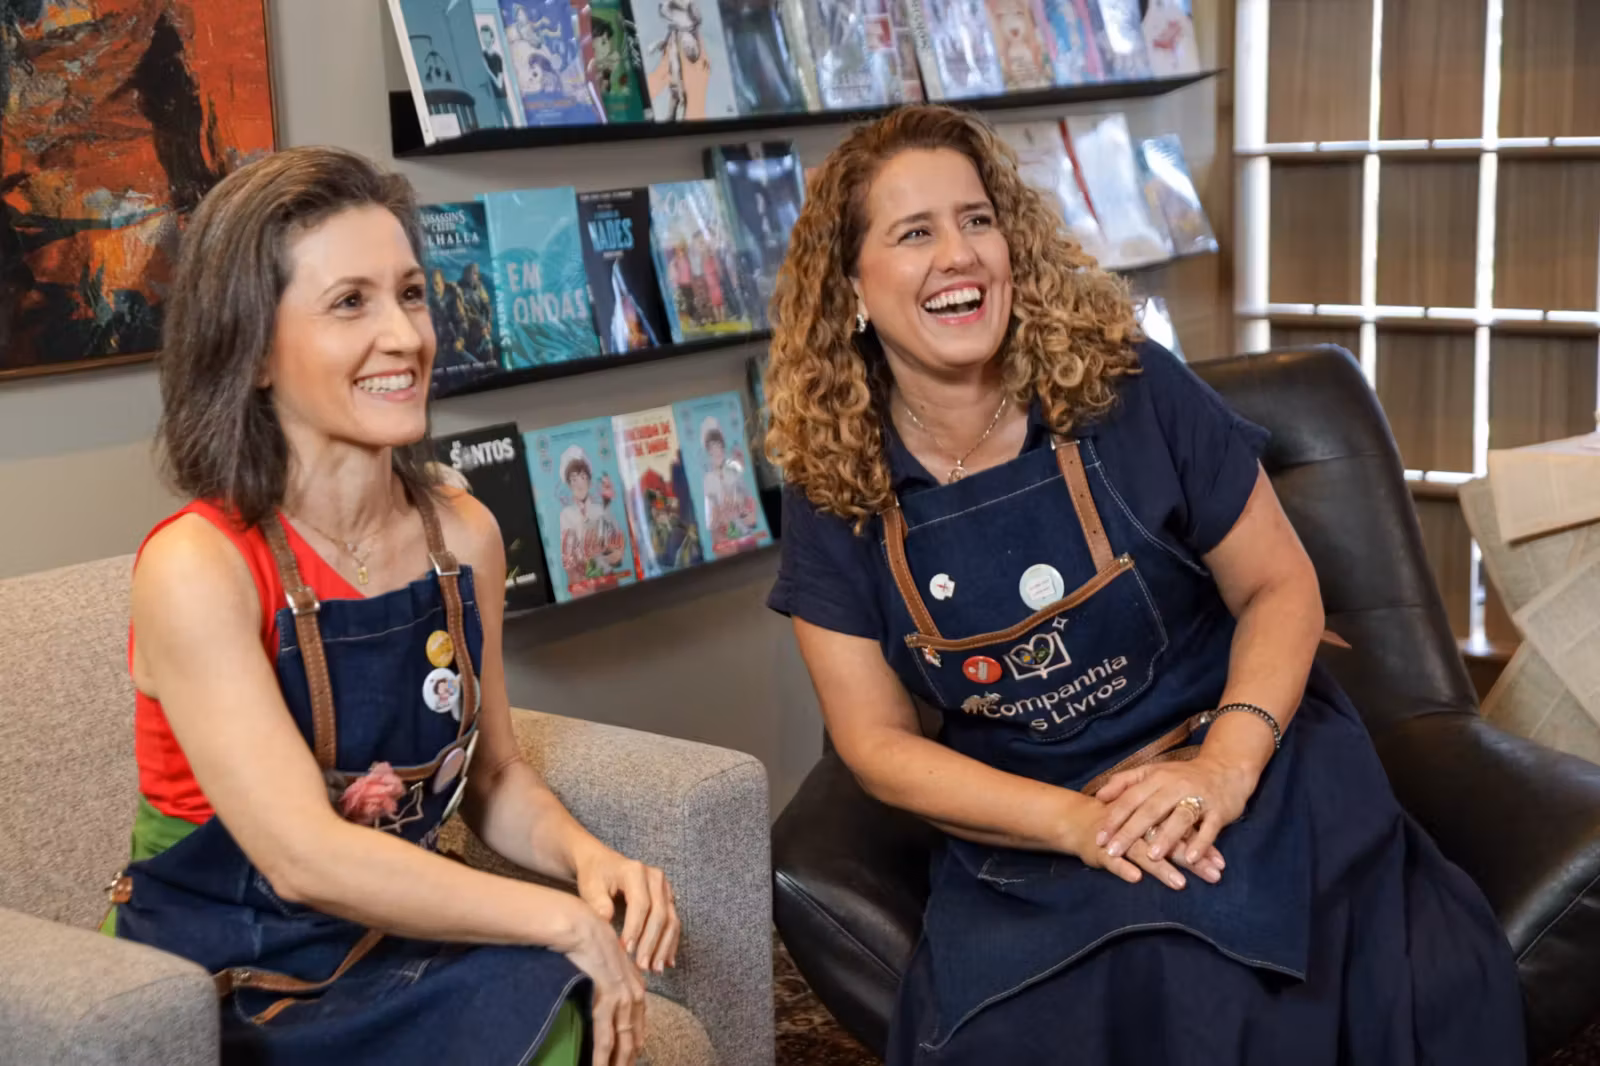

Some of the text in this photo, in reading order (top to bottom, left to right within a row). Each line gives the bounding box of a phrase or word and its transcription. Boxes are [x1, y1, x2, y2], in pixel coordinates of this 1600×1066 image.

[506, 262, 543, 292] EM
[513, 288, 588, 323] ONDAS
[450, 437, 515, 470] SANTOS
[983, 655, 1128, 718] Companhia
[1052, 676, 1127, 725] Livros
